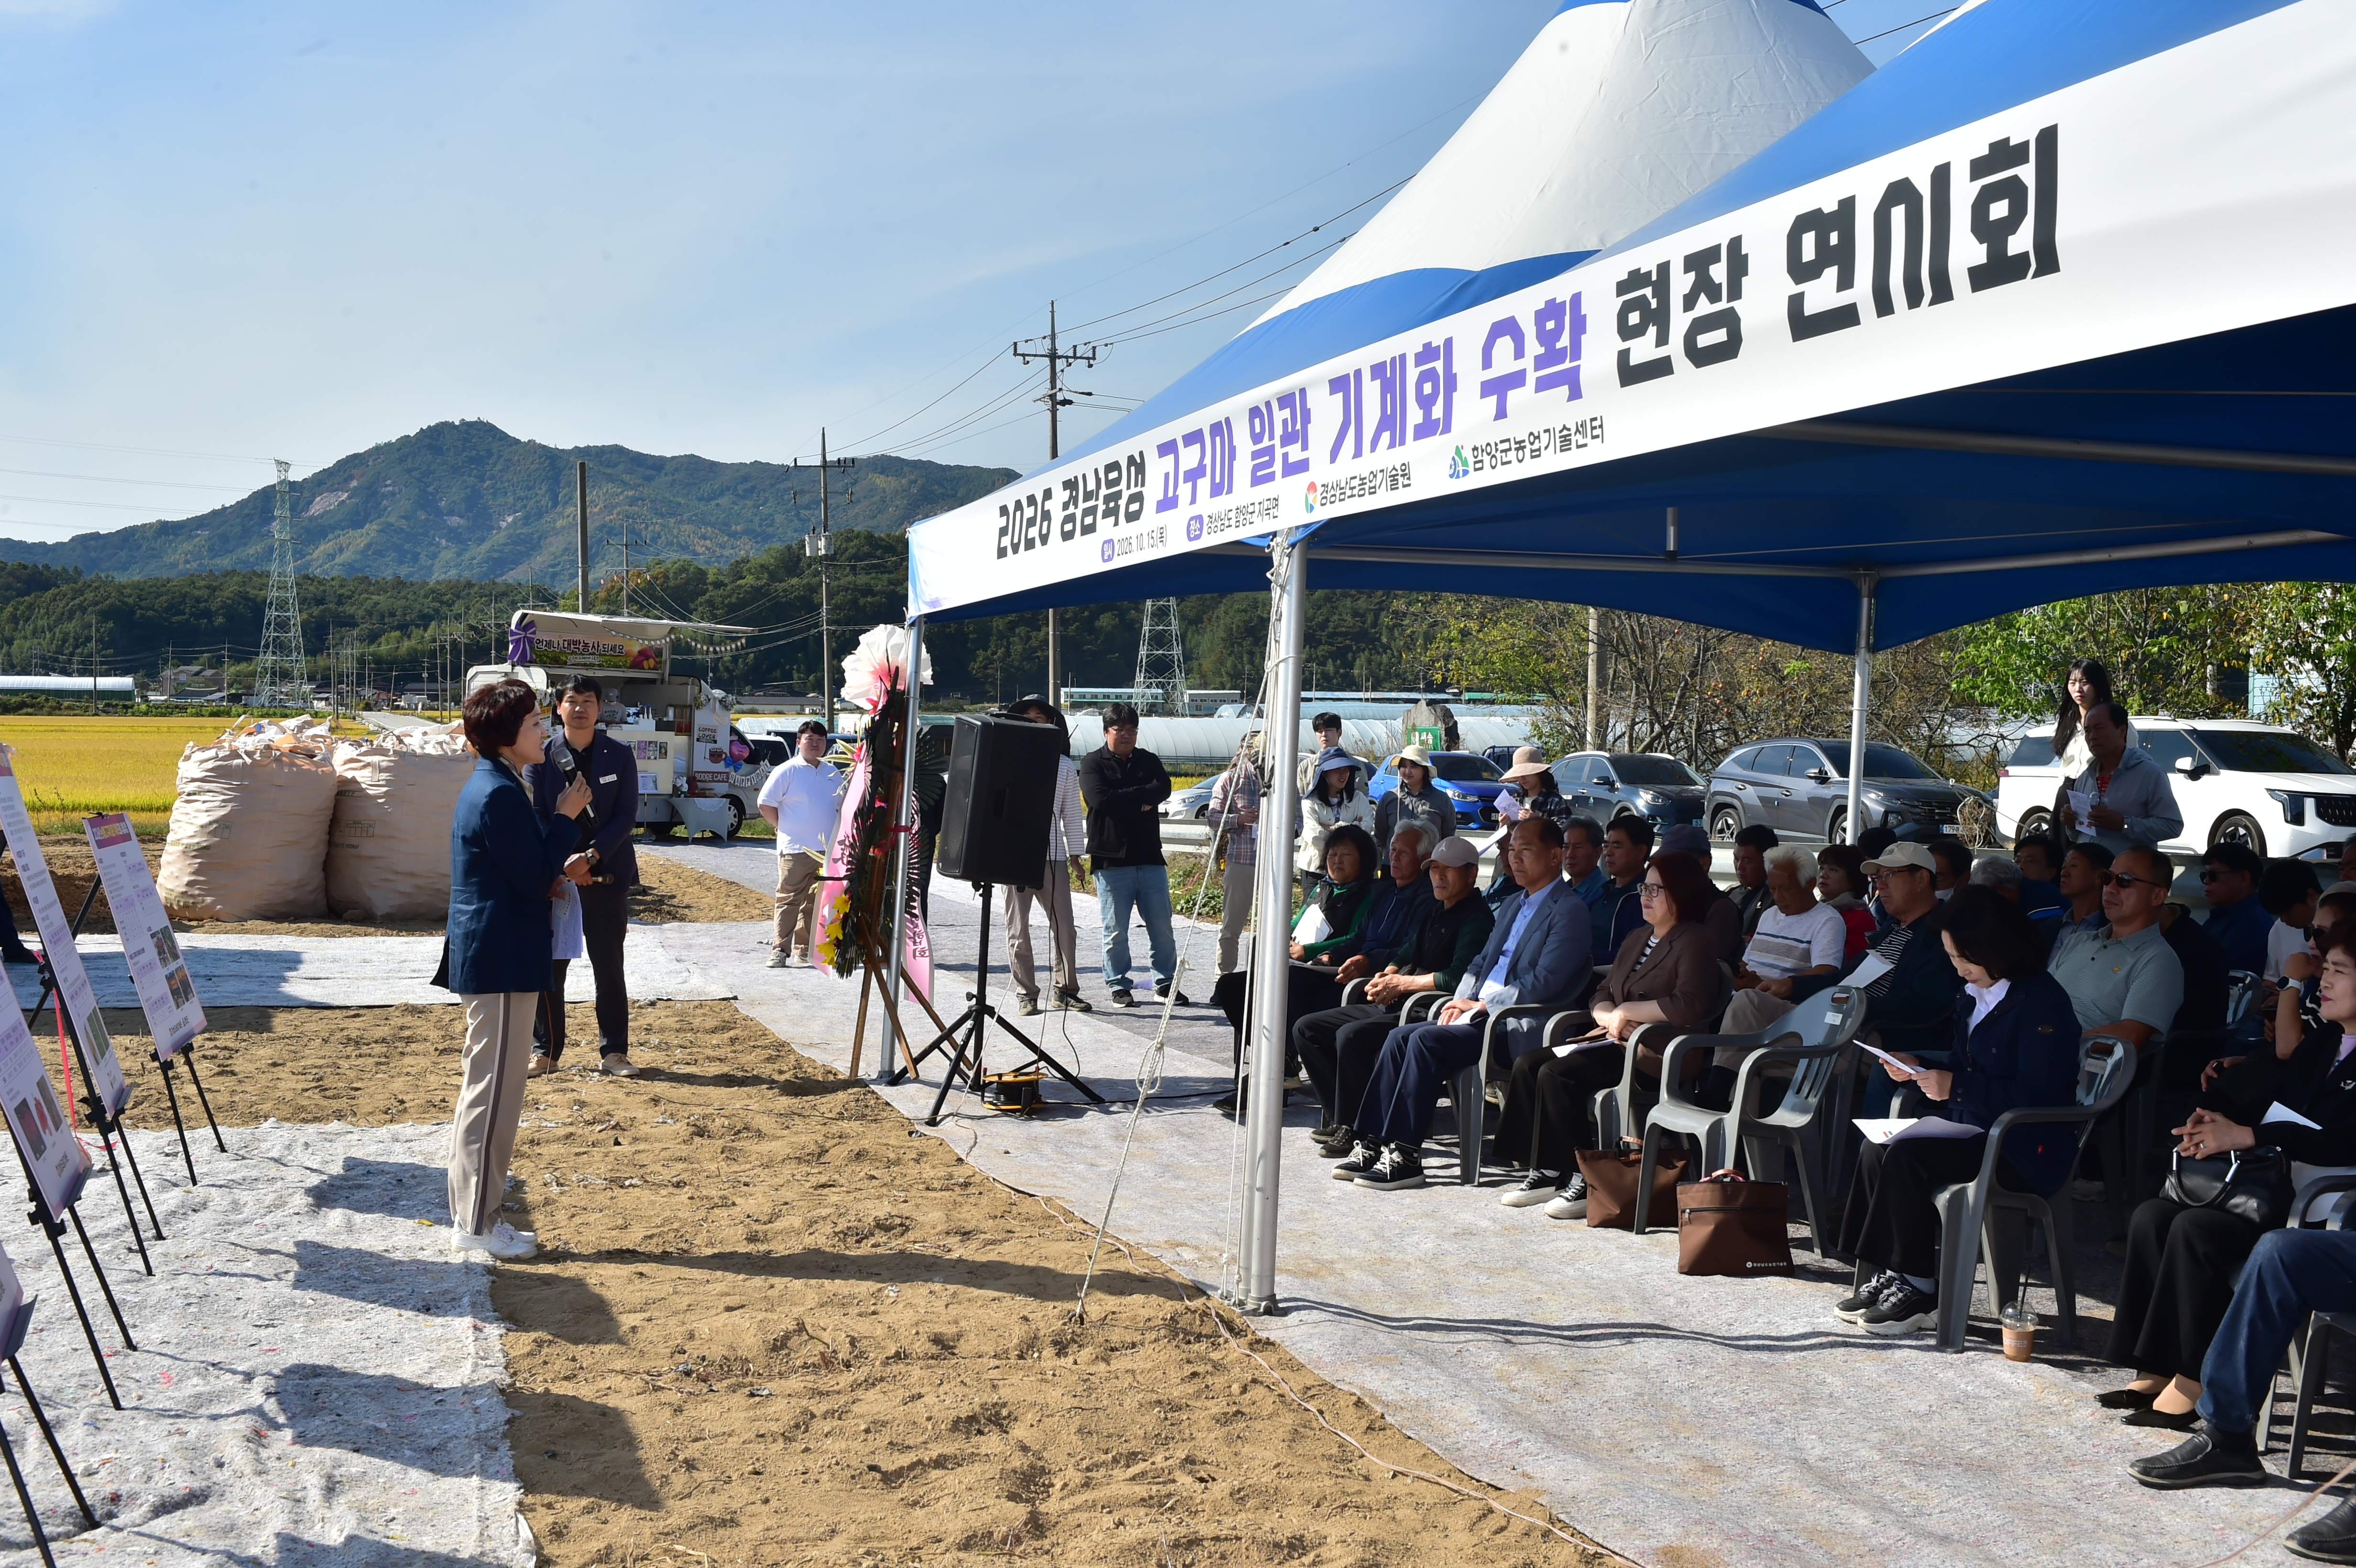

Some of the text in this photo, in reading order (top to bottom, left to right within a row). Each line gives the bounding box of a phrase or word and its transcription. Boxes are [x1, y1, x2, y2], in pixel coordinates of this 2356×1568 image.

[997, 123, 2061, 559] 2026 경남육성 고구마 일관 기계화 수확 현장 연시회
[1472, 415, 1604, 471] 함양군농업기술센터
[1320, 461, 1411, 506] 경상남도농업기술원
[1189, 495, 1279, 538] 장소 경상남도 함양군 지곡면
[1103, 524, 1167, 560] 일시 2026. 10. 15.(목)
[534, 638, 625, 655] 언제나 대박농사 되세요
[695, 773, 712, 781] BODRE
